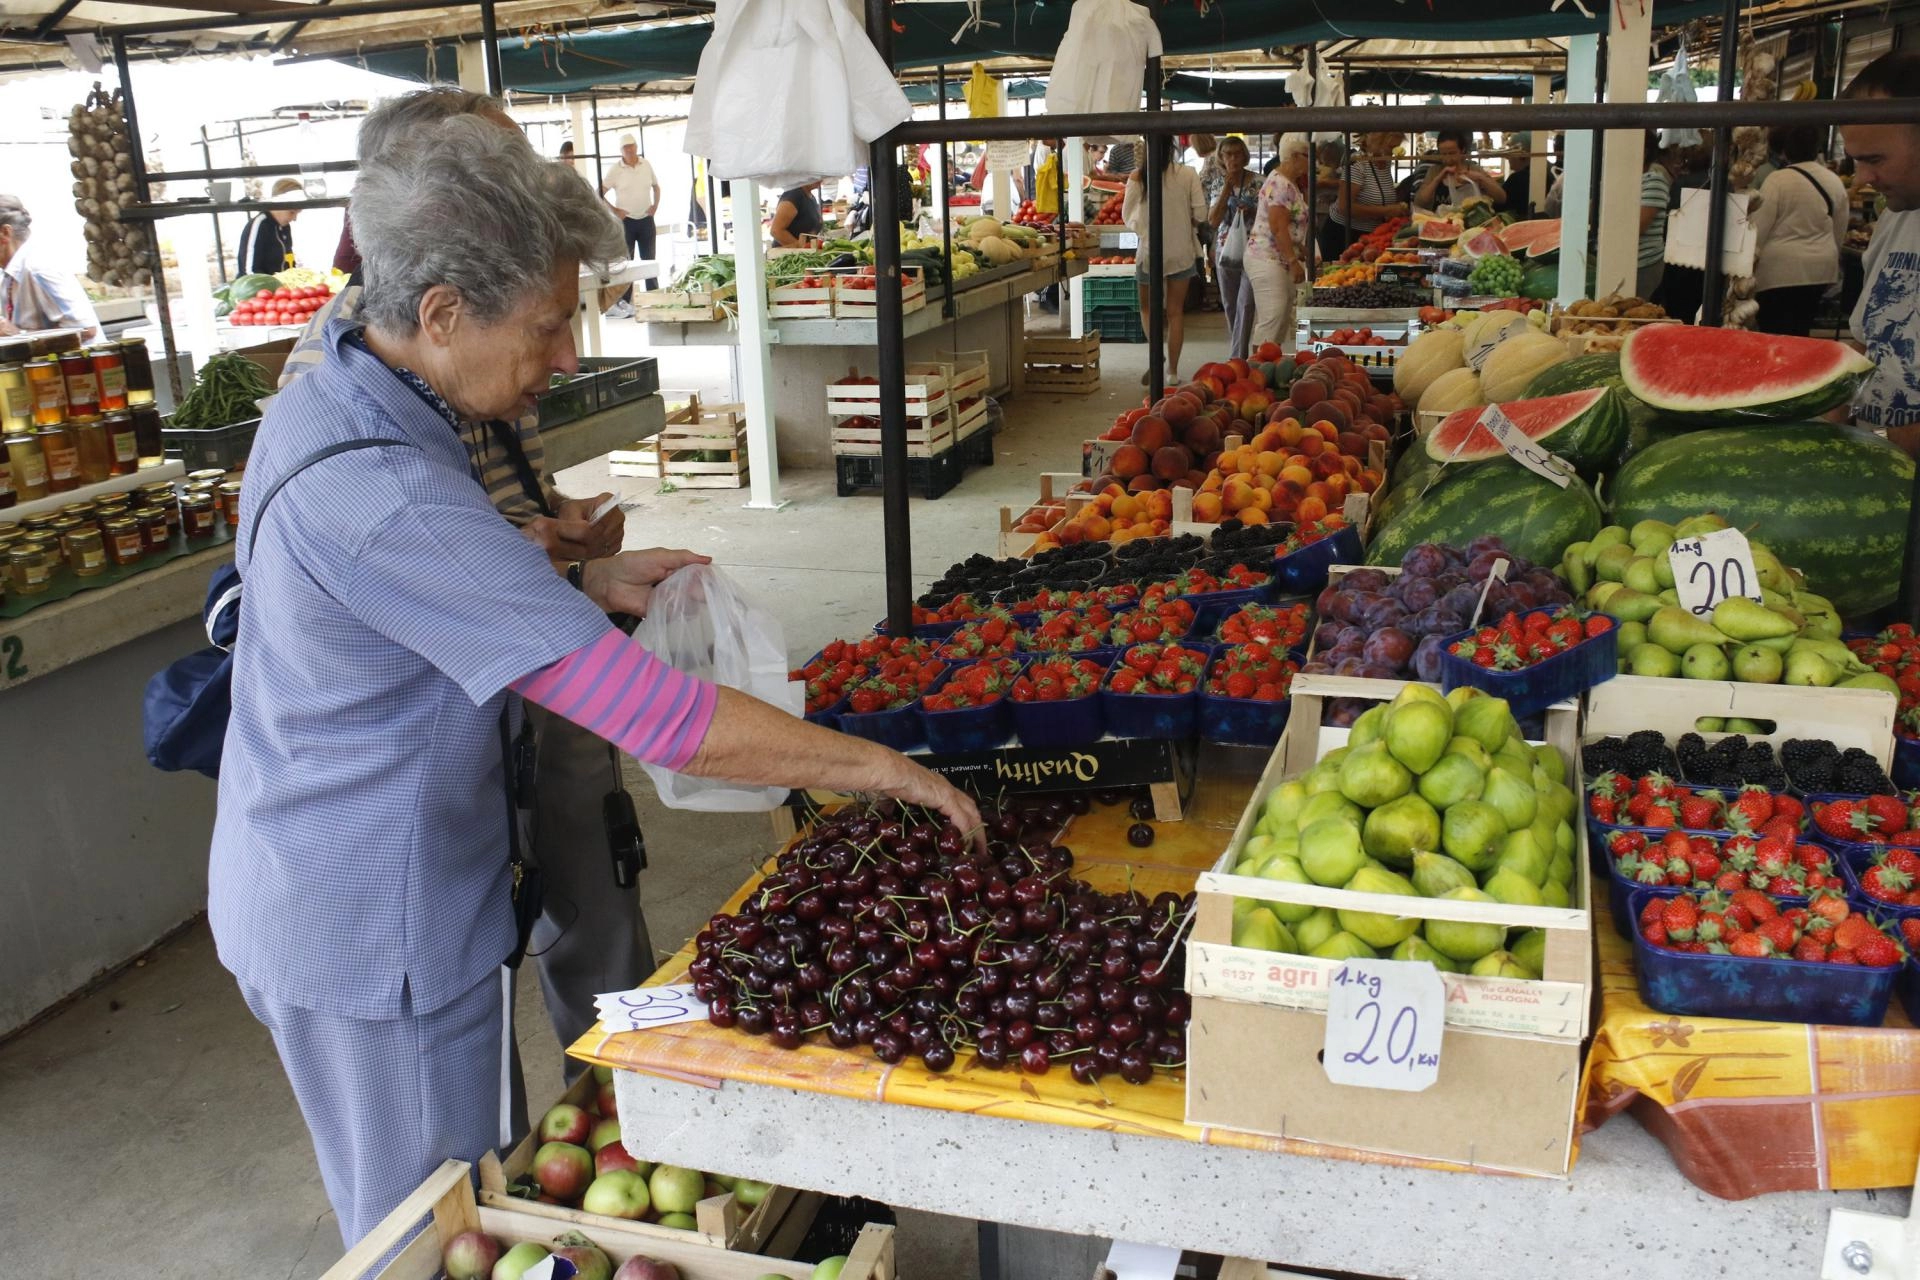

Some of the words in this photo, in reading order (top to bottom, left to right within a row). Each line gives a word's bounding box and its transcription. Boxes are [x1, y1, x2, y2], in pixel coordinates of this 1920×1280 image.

[0, 635, 29, 680] 2
[950, 764, 981, 773] moment
[996, 752, 1099, 785] Quality
[1222, 968, 1255, 982] 6137
[1267, 965, 1318, 989] agri
[1481, 994, 1540, 1004] BOLOGNA
